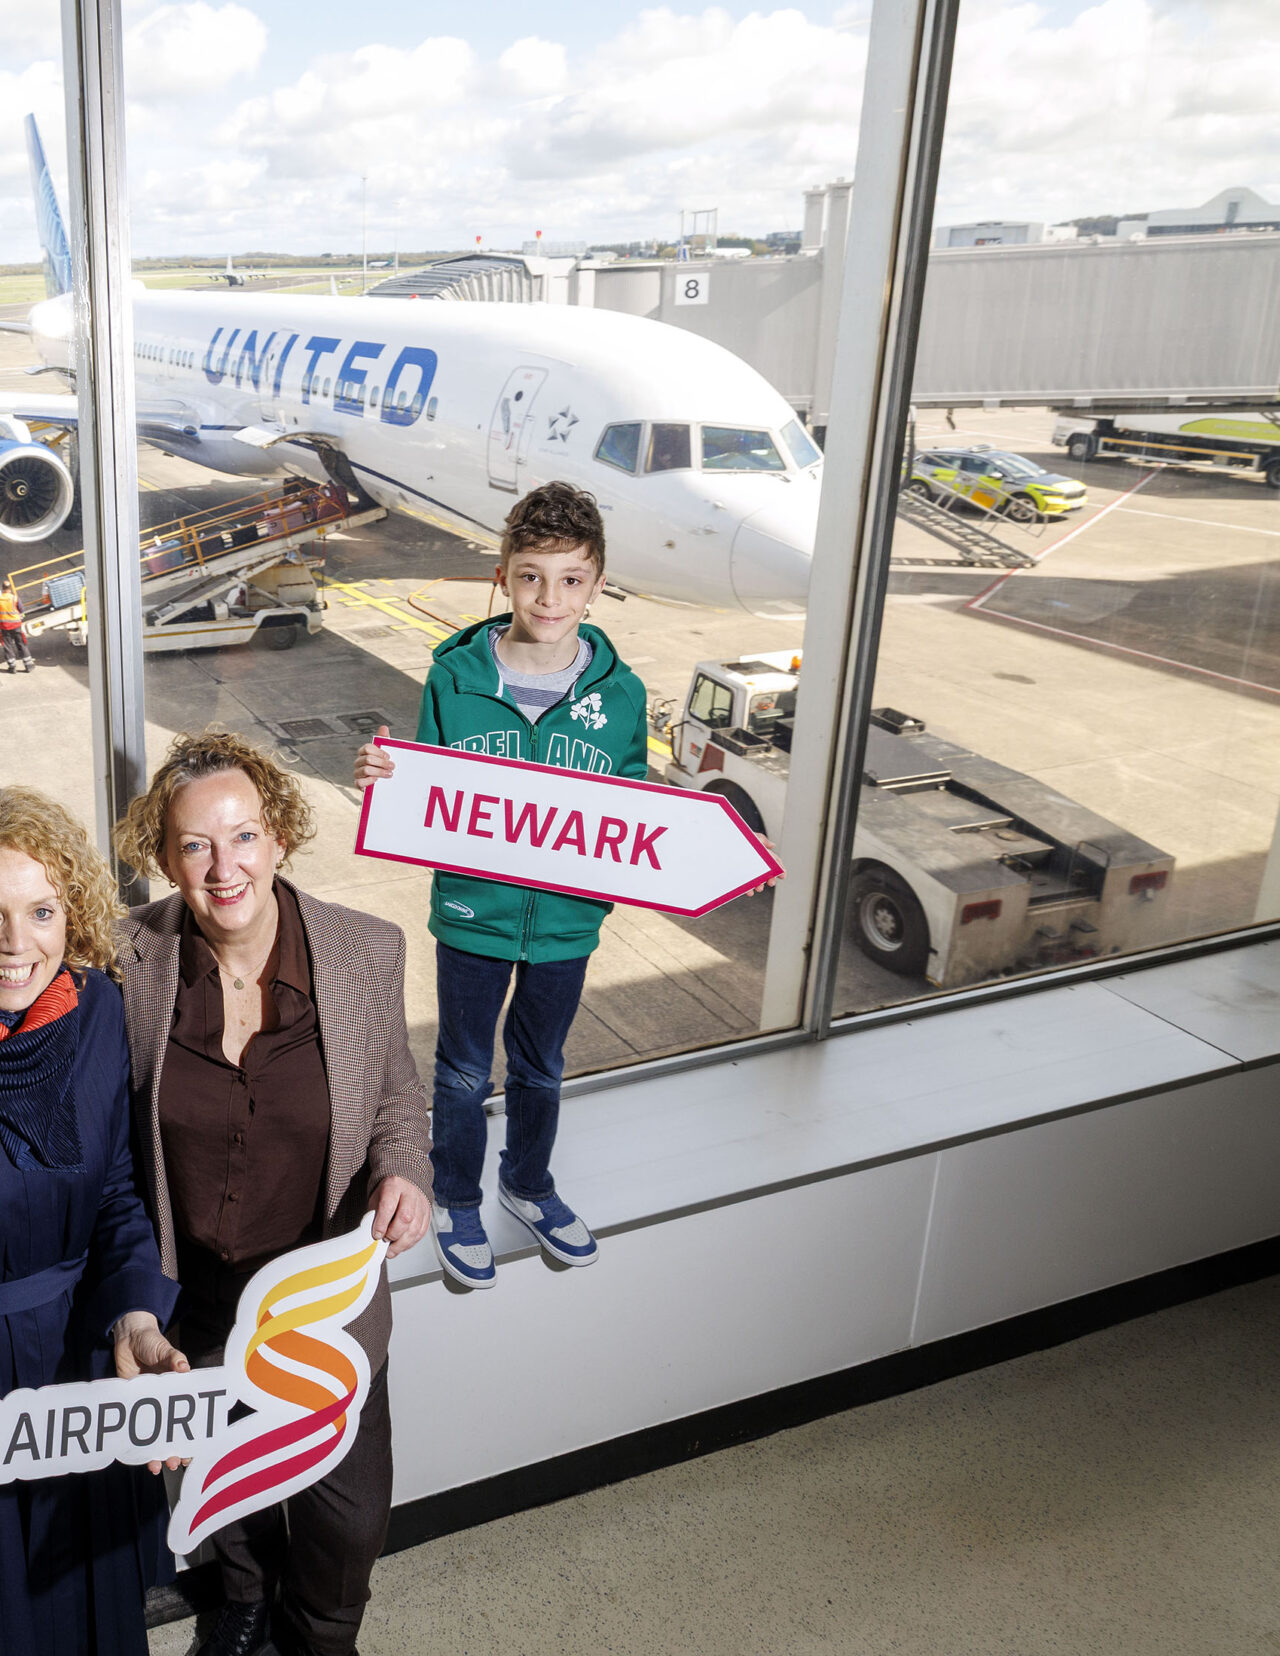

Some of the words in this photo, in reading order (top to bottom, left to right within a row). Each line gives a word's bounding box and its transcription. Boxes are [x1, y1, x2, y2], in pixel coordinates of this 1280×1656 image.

[685, 279, 699, 299] 8
[205, 327, 438, 427] UNITED
[423, 785, 669, 871] NEWARK
[2, 1388, 227, 1466] AIRPORT
